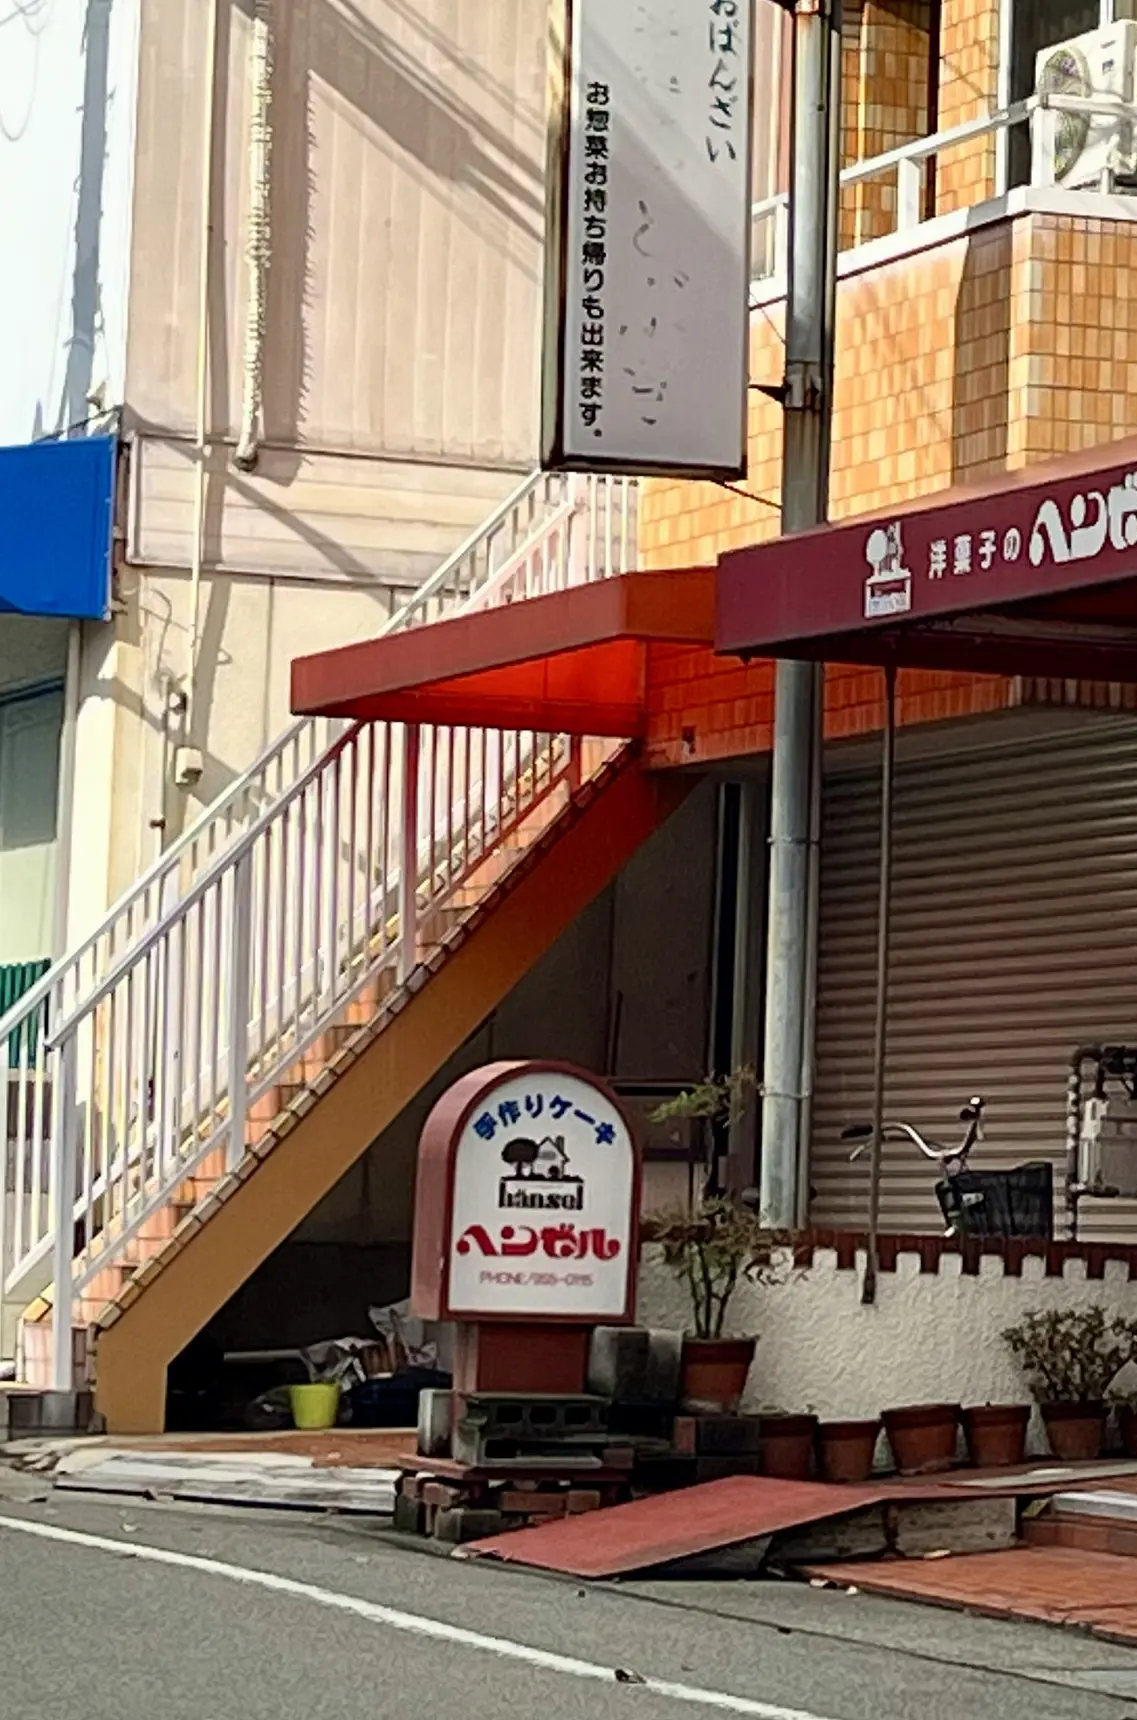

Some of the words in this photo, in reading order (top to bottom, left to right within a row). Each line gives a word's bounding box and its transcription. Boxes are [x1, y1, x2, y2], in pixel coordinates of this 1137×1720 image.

[928, 527, 1021, 579] 洋菓子の
[473, 1094, 616, 1146] 手作りケーキ
[456, 1223, 621, 1261] ヘンゼル
